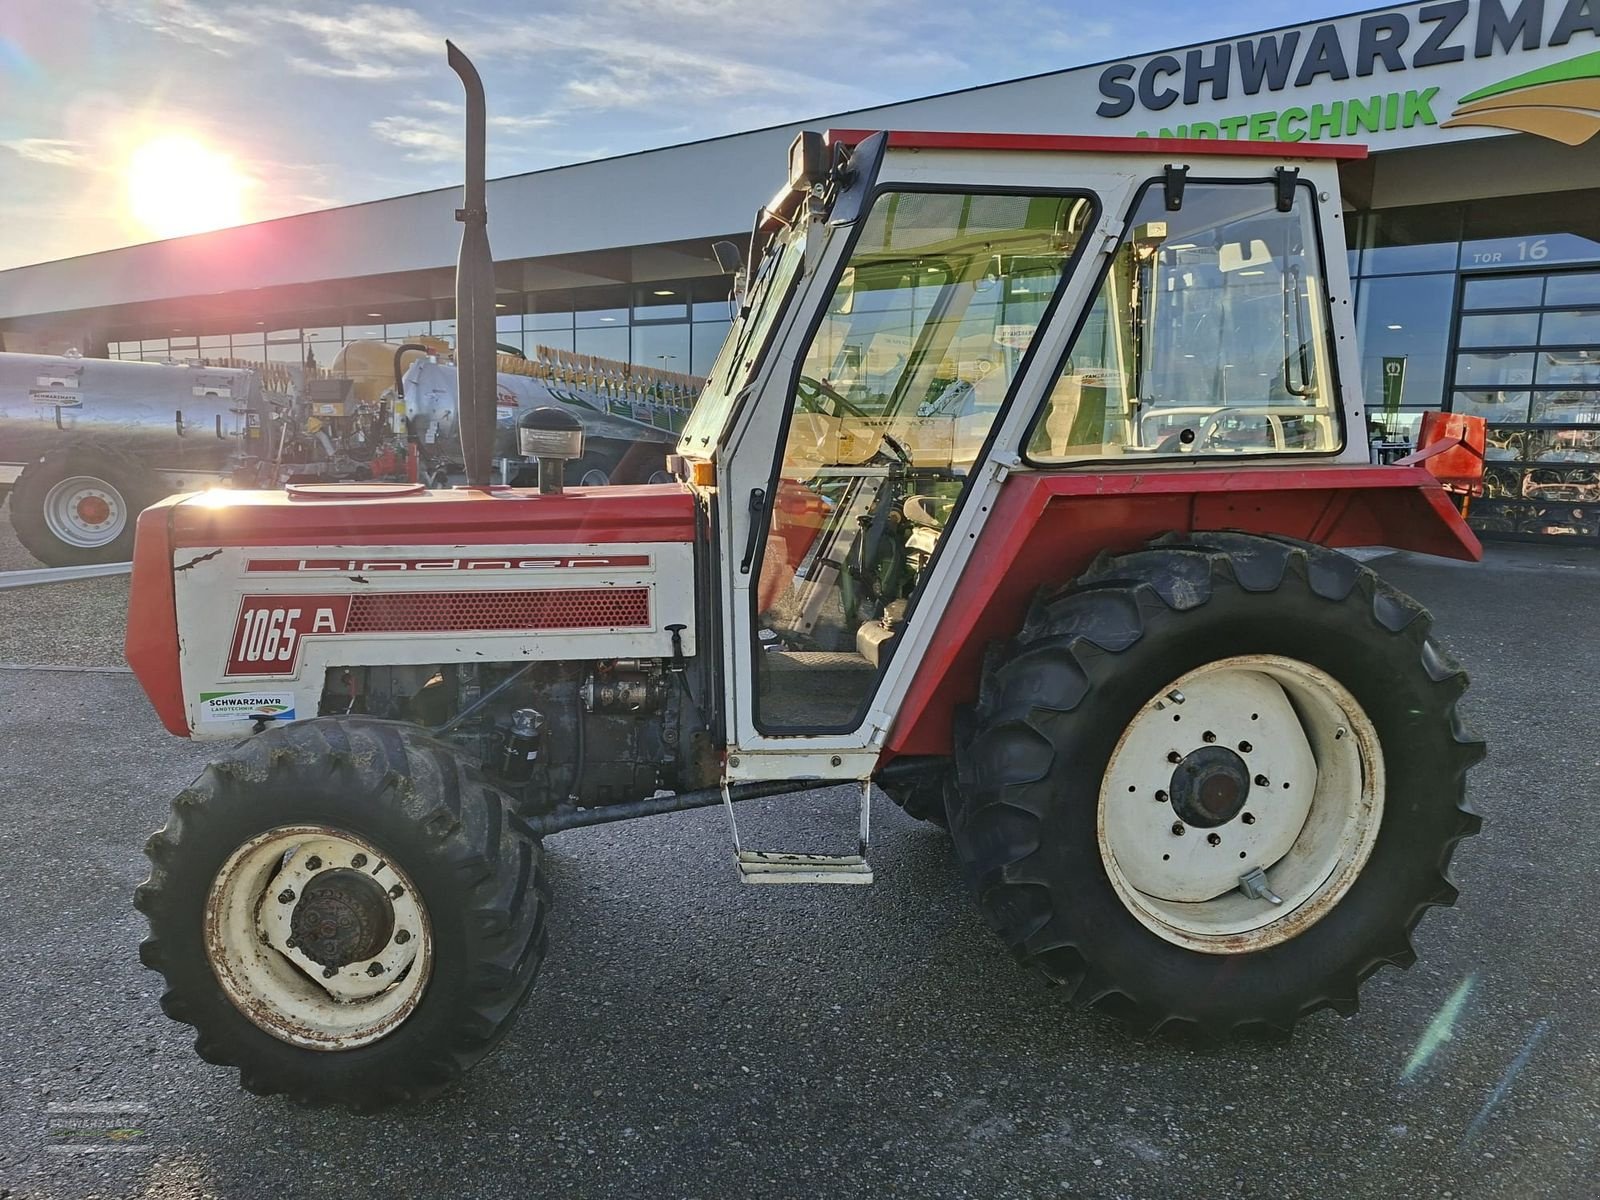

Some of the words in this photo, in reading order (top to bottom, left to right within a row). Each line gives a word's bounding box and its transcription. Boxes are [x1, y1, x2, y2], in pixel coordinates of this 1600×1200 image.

[1473, 252, 1502, 263] TOR
[1518, 239, 1548, 261] 16
[298, 559, 610, 571] Lindner
[238, 608, 302, 661] 1065
[312, 608, 337, 632] A
[209, 698, 281, 707] SCHWARZMAYR
